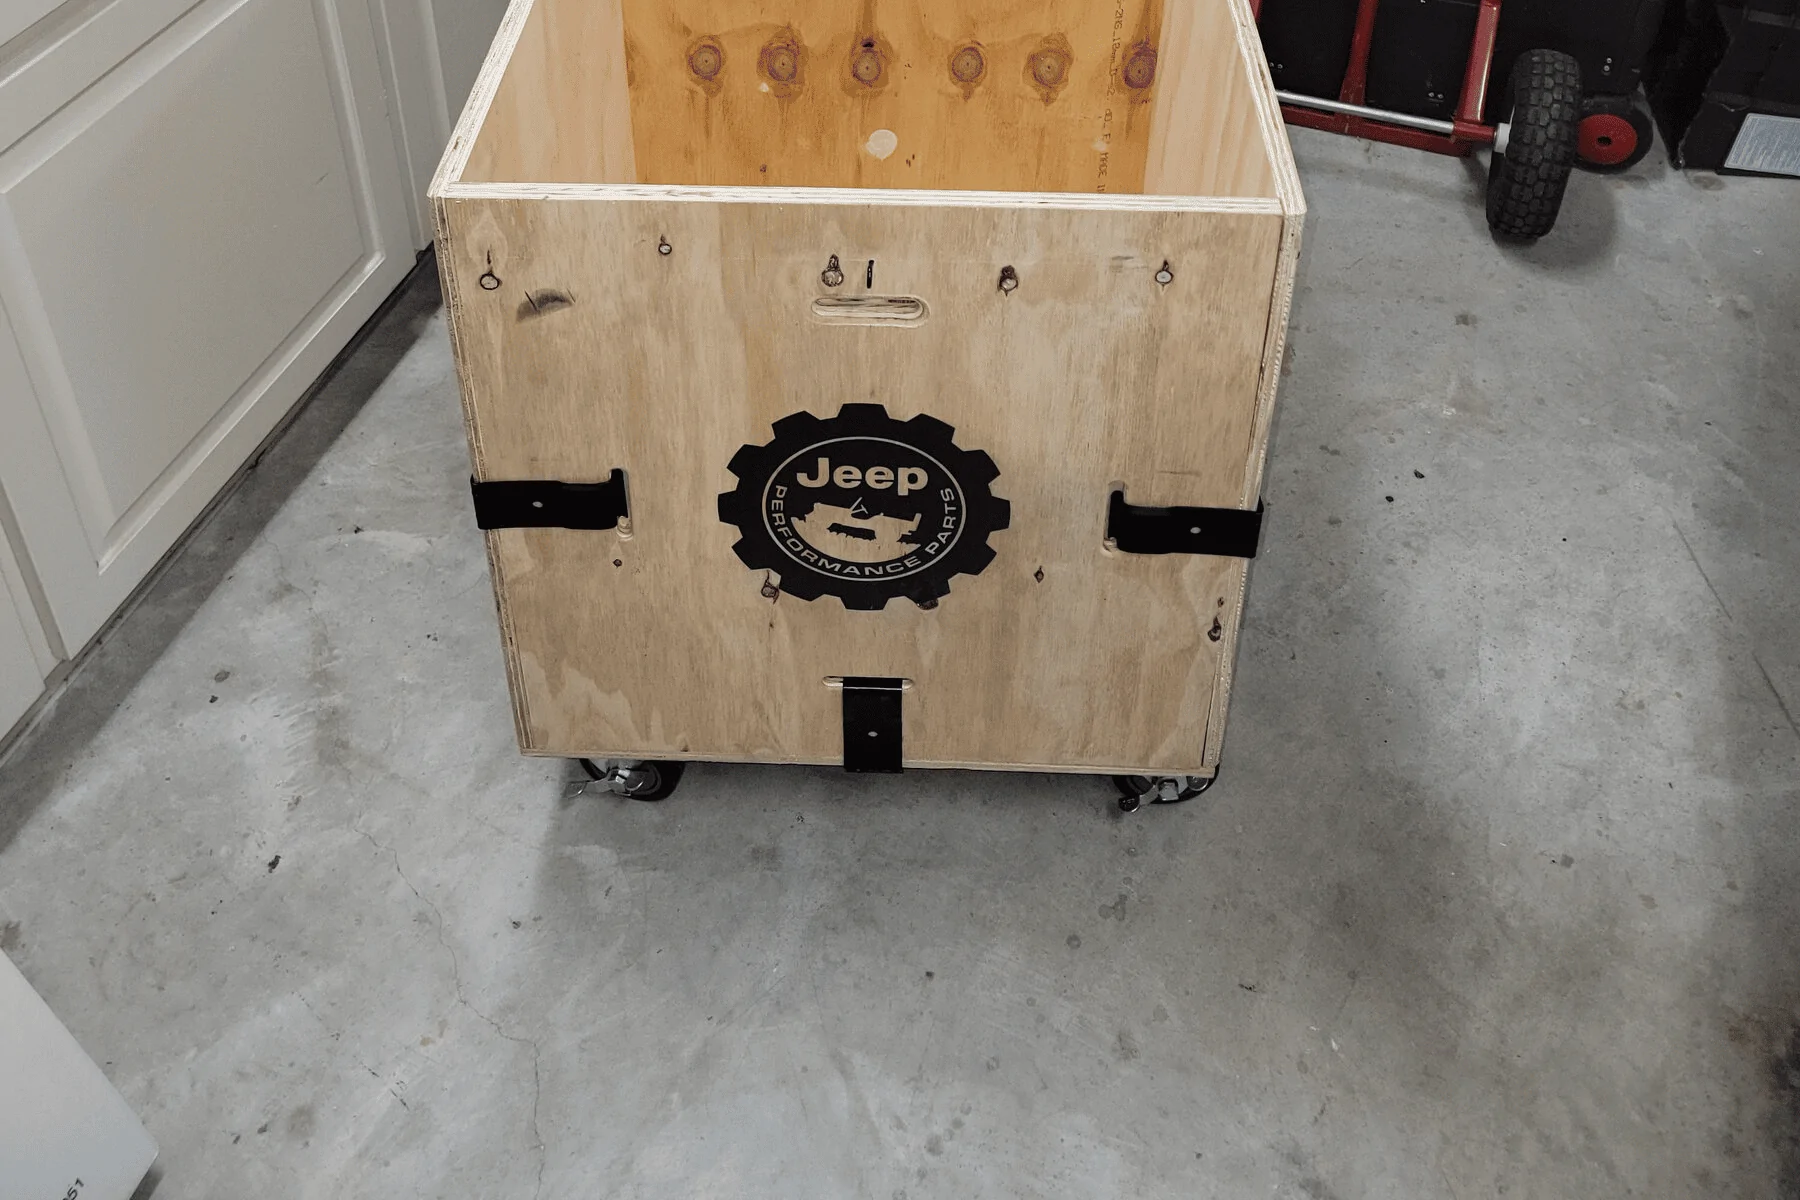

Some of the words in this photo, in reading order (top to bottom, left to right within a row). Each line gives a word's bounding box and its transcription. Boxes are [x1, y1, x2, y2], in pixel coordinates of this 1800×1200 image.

[1097, 151, 1109, 179] MADE
[796, 457, 929, 496] Jeep
[770, 484, 922, 576] PERFORMANCE
[925, 487, 956, 555] PARTS
